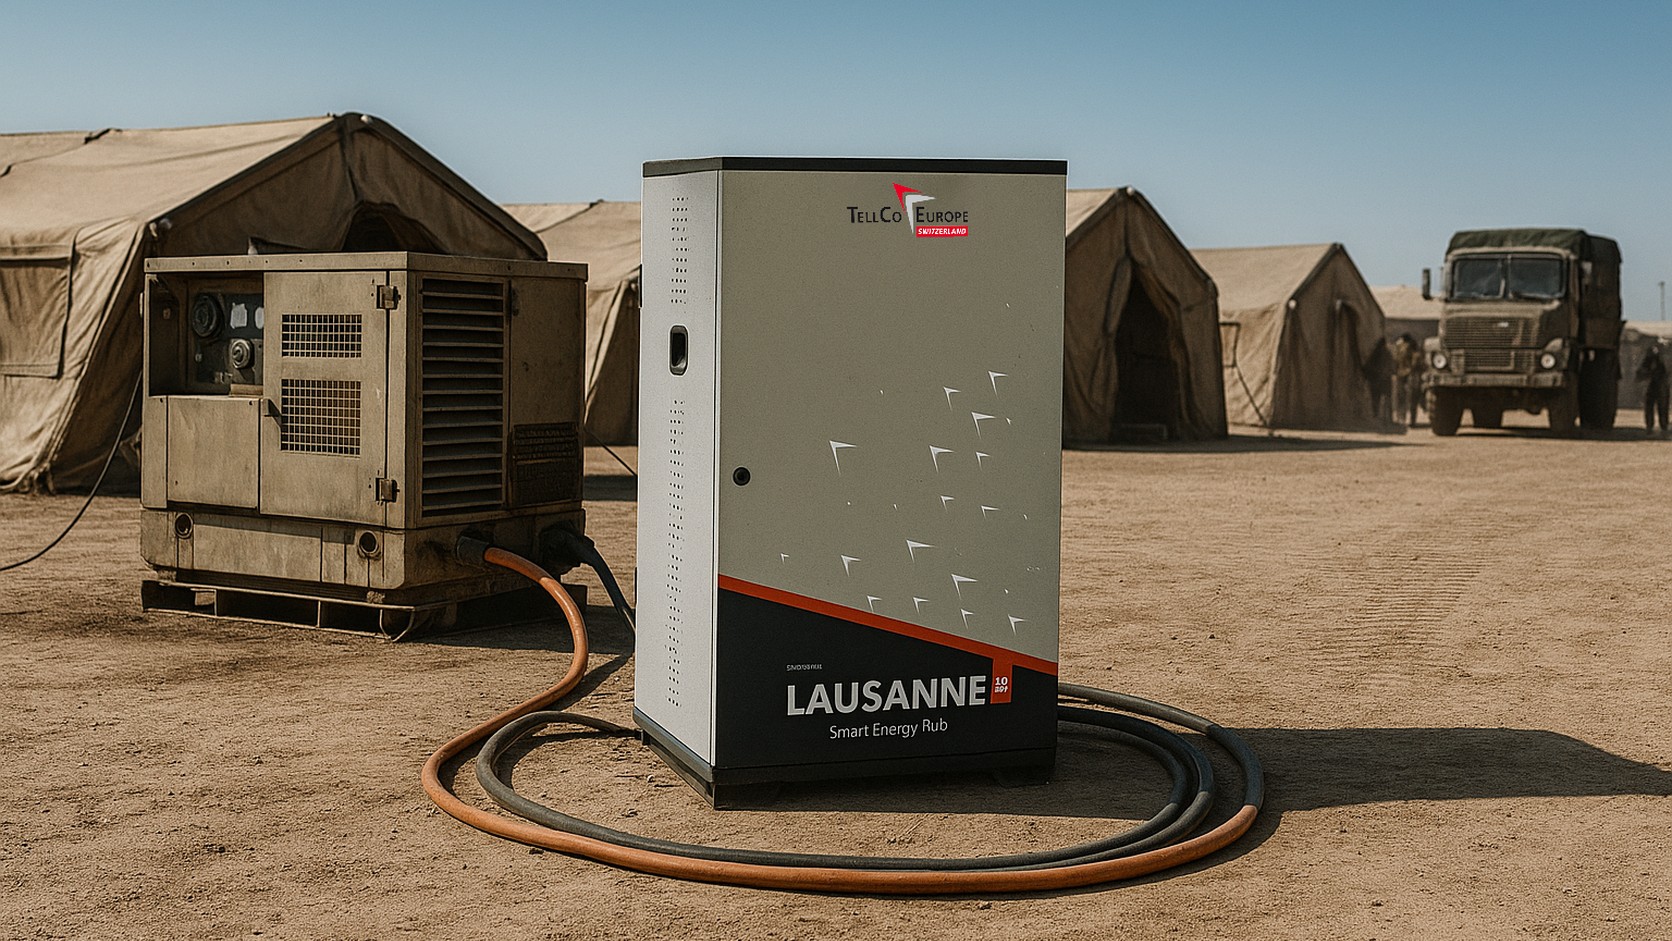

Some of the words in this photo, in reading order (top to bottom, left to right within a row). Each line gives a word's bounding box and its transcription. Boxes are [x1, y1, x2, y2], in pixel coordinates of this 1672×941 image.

[918, 227, 967, 235] SWITZERLAND
[994, 676, 1008, 686] 10
[787, 675, 986, 716] LAUSANNE
[829, 725, 869, 739] Smart
[872, 722, 918, 739] Energy
[922, 717, 948, 733] Rub
